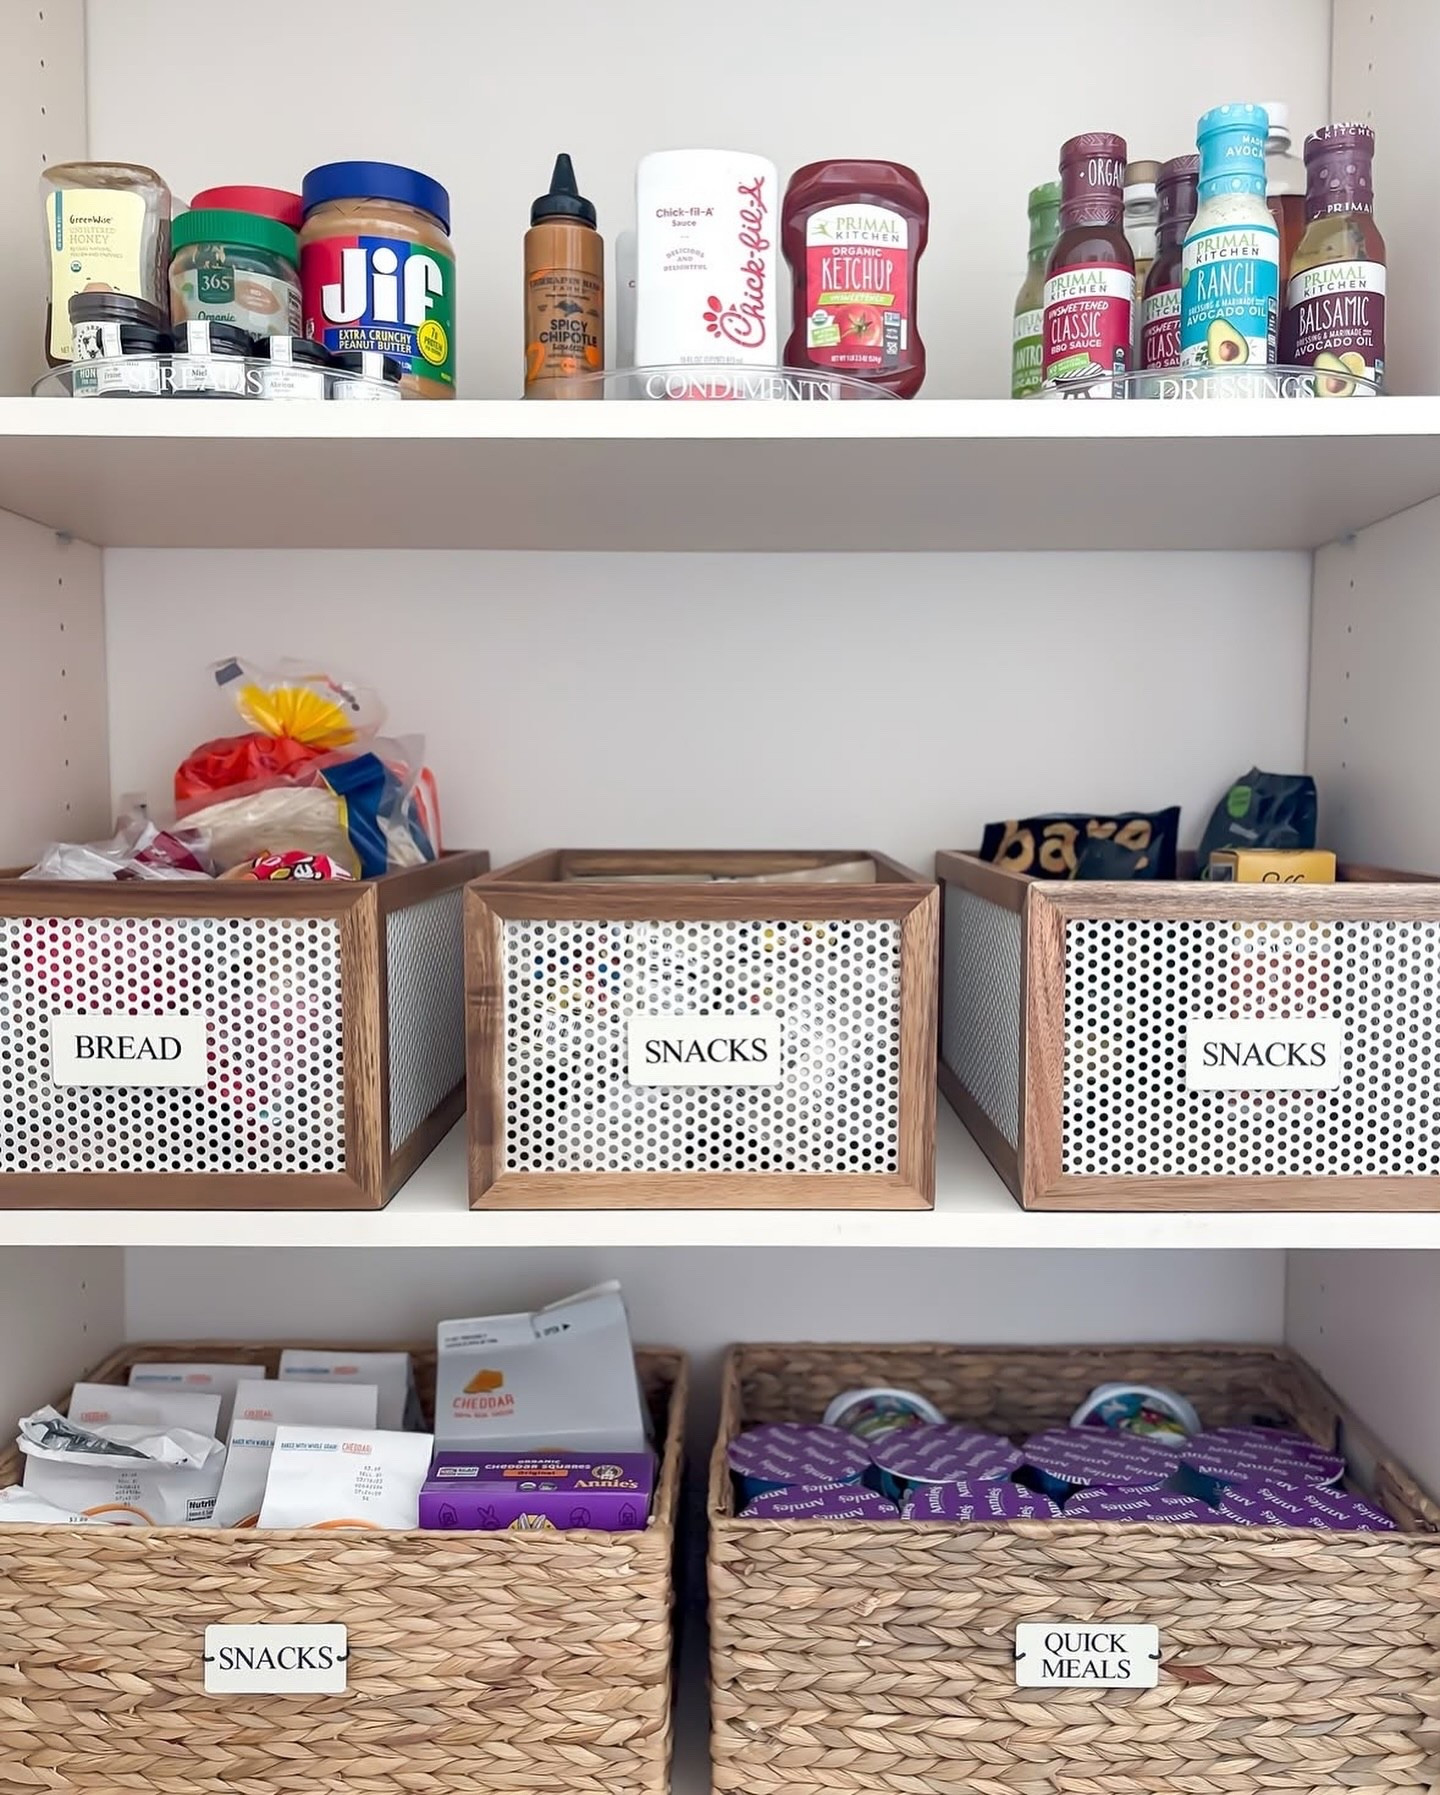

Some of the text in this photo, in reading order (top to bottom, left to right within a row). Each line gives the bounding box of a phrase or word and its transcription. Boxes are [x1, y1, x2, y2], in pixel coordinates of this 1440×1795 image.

[1226, 146, 1263, 157] AVOCA
[69, 214, 111, 224] GreenWise
[656, 207, 714, 218] Chick-fil-A
[672, 219, 697, 227] Sauce
[837, 217, 898, 234] PRIMAL
[70, 234, 109, 244] HONEY
[836, 231, 899, 242] KITCHEN
[1197, 233, 1258, 255] PRIMAL
[719, 176, 770, 348] Chick-fil-A
[832, 247, 882, 257] ORGANIC
[1196, 247, 1260, 264] KITCHEN
[201, 274, 230, 291] 365
[822, 257, 893, 291] KETCHUP
[1051, 271, 1106, 293] PRIMAL
[1198, 261, 1254, 302] RANCH
[1304, 266, 1366, 288] PRIMAL
[321, 247, 443, 327] Jif
[1051, 285, 1107, 300] KITCHEN
[1303, 280, 1367, 297] KITCHEN
[1146, 293, 1178, 312] PRIM
[550, 319, 588, 332] SPICY
[1187, 305, 1266, 326] AVOCADO OIL
[1300, 296, 1369, 336] BALSAMIC
[339, 329, 411, 345] EXTRA CRUNCHY
[1051, 311, 1101, 344] CLASSIC
[339, 340, 412, 353] PEANUT BUTTER
[539, 331, 597, 347] CHIPOTLE
[1069, 339, 1102, 350] SAUCE
[1147, 331, 1181, 362] CLASS
[1295, 336, 1374, 358] AVOCADO OIL
[645, 373, 832, 400] CONDIMENTS
[1157, 375, 1316, 400] DRESSINGS
[75, 1035, 182, 1060] BREAD
[645, 1037, 768, 1064] SNACKS
[1202, 1041, 1326, 1067] SNACKS
[452, 1393, 514, 1410] CHEDDAR
[574, 1478, 639, 1490] Annie's
[1044, 1631, 1128, 1657] QUICK
[218, 1645, 333, 1671] SNACKS
[1042, 1658, 1131, 1680] MEALS
